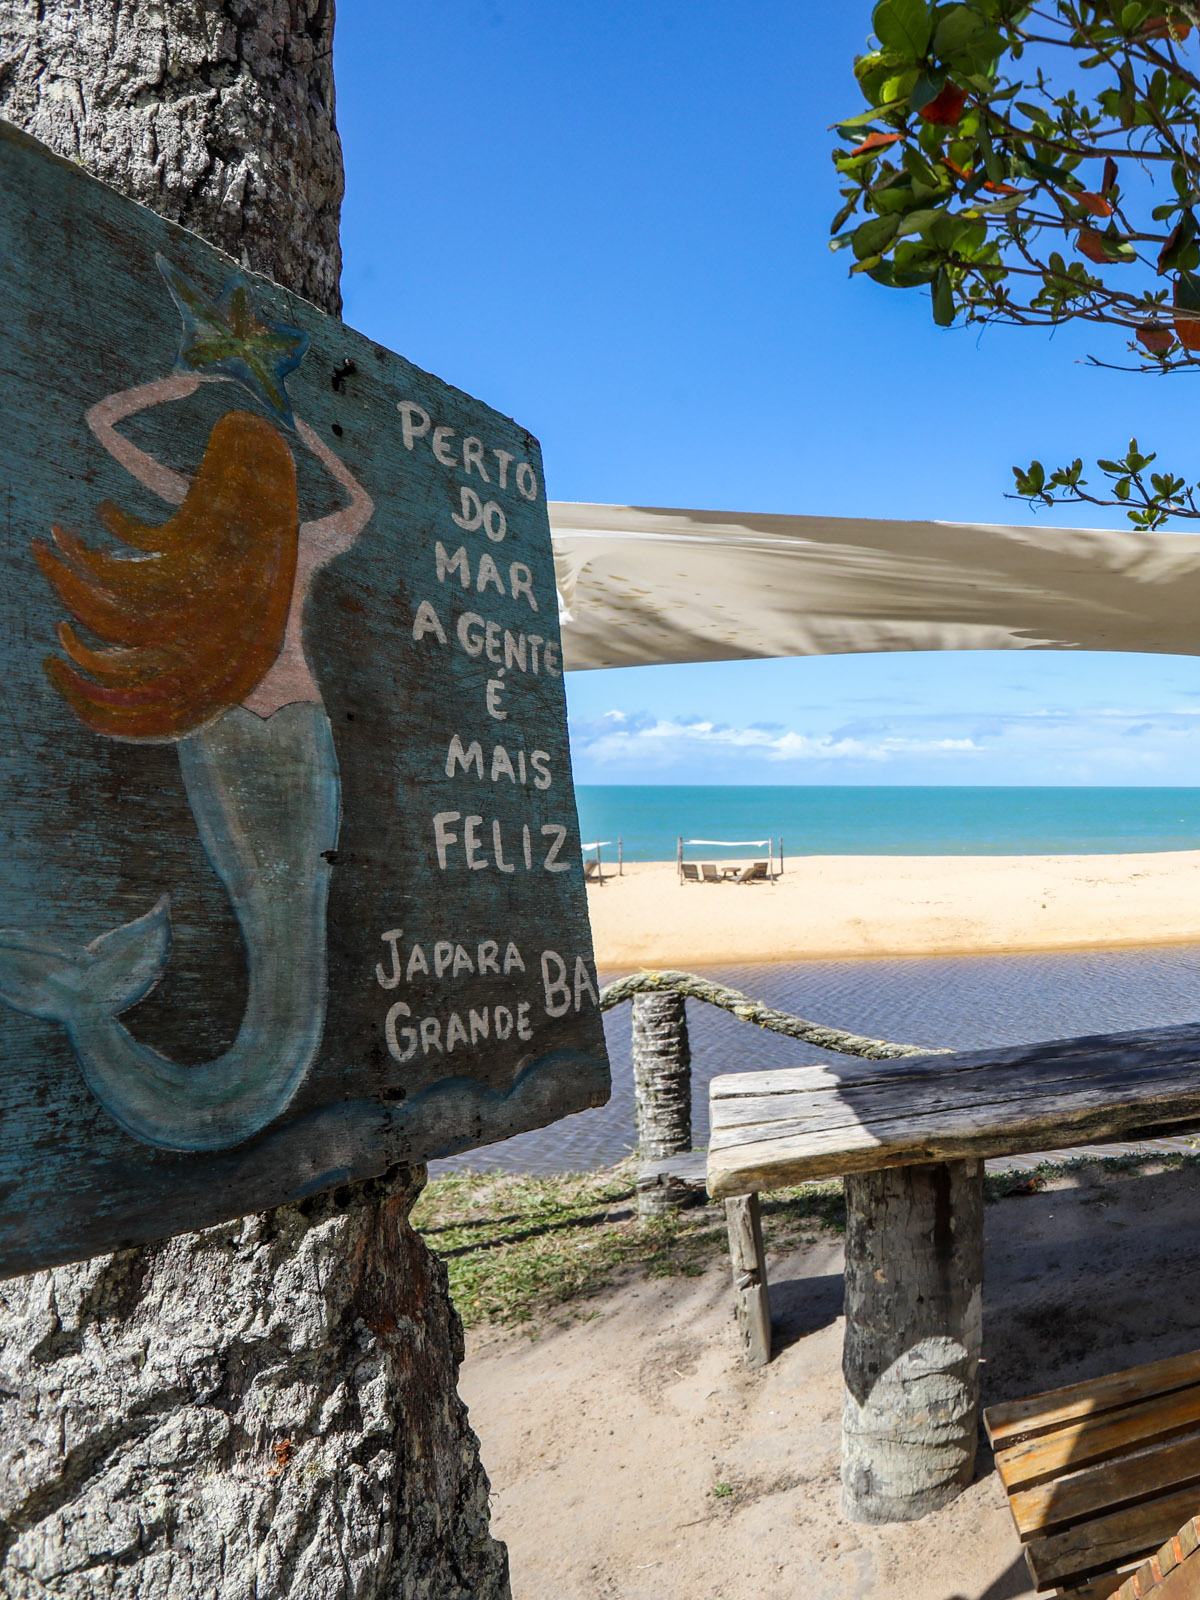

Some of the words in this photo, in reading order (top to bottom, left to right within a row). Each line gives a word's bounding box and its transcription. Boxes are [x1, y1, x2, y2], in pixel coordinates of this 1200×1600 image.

[397, 400, 537, 501] PERTO
[452, 487, 507, 542] DO
[435, 541, 538, 612] MAR
[413, 600, 447, 644] A
[457, 612, 561, 677] GENTE
[486, 667, 507, 720] É
[445, 734, 551, 790] MAIS
[433, 811, 571, 872] FELIZ
[375, 929, 526, 990] JAPARA
[541, 950, 599, 1018] BA
[385, 1001, 534, 1063] GRANDE
